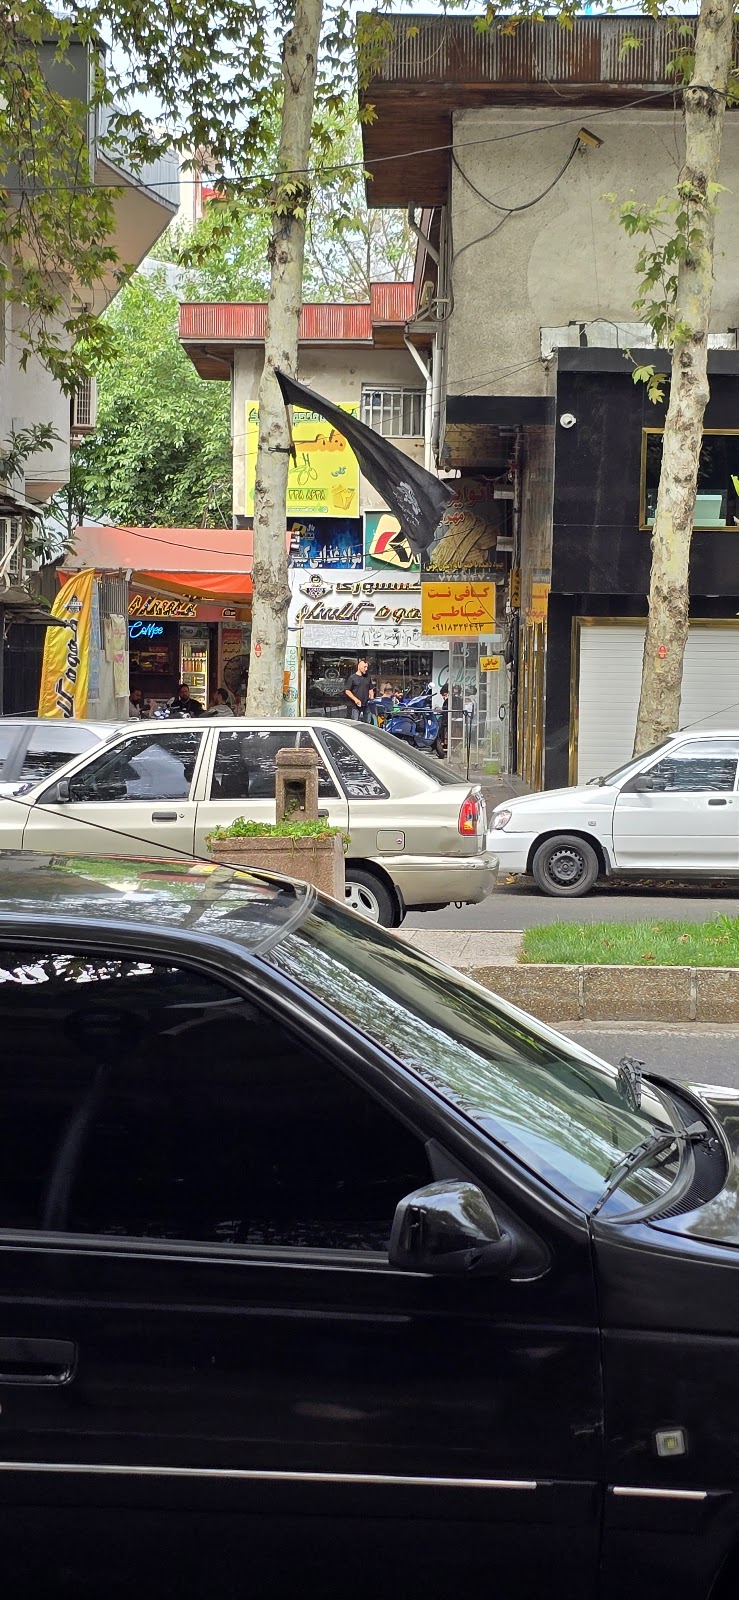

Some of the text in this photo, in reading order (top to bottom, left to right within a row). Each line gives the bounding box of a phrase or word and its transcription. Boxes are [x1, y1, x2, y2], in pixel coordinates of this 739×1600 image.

[310, 545, 340, 569] غذایی
[341, 546, 361, 568] مواد
[428, 586, 490, 601] کافی نت
[432, 605, 485, 620] خیاطی
[128, 621, 164, 638] Coffee
